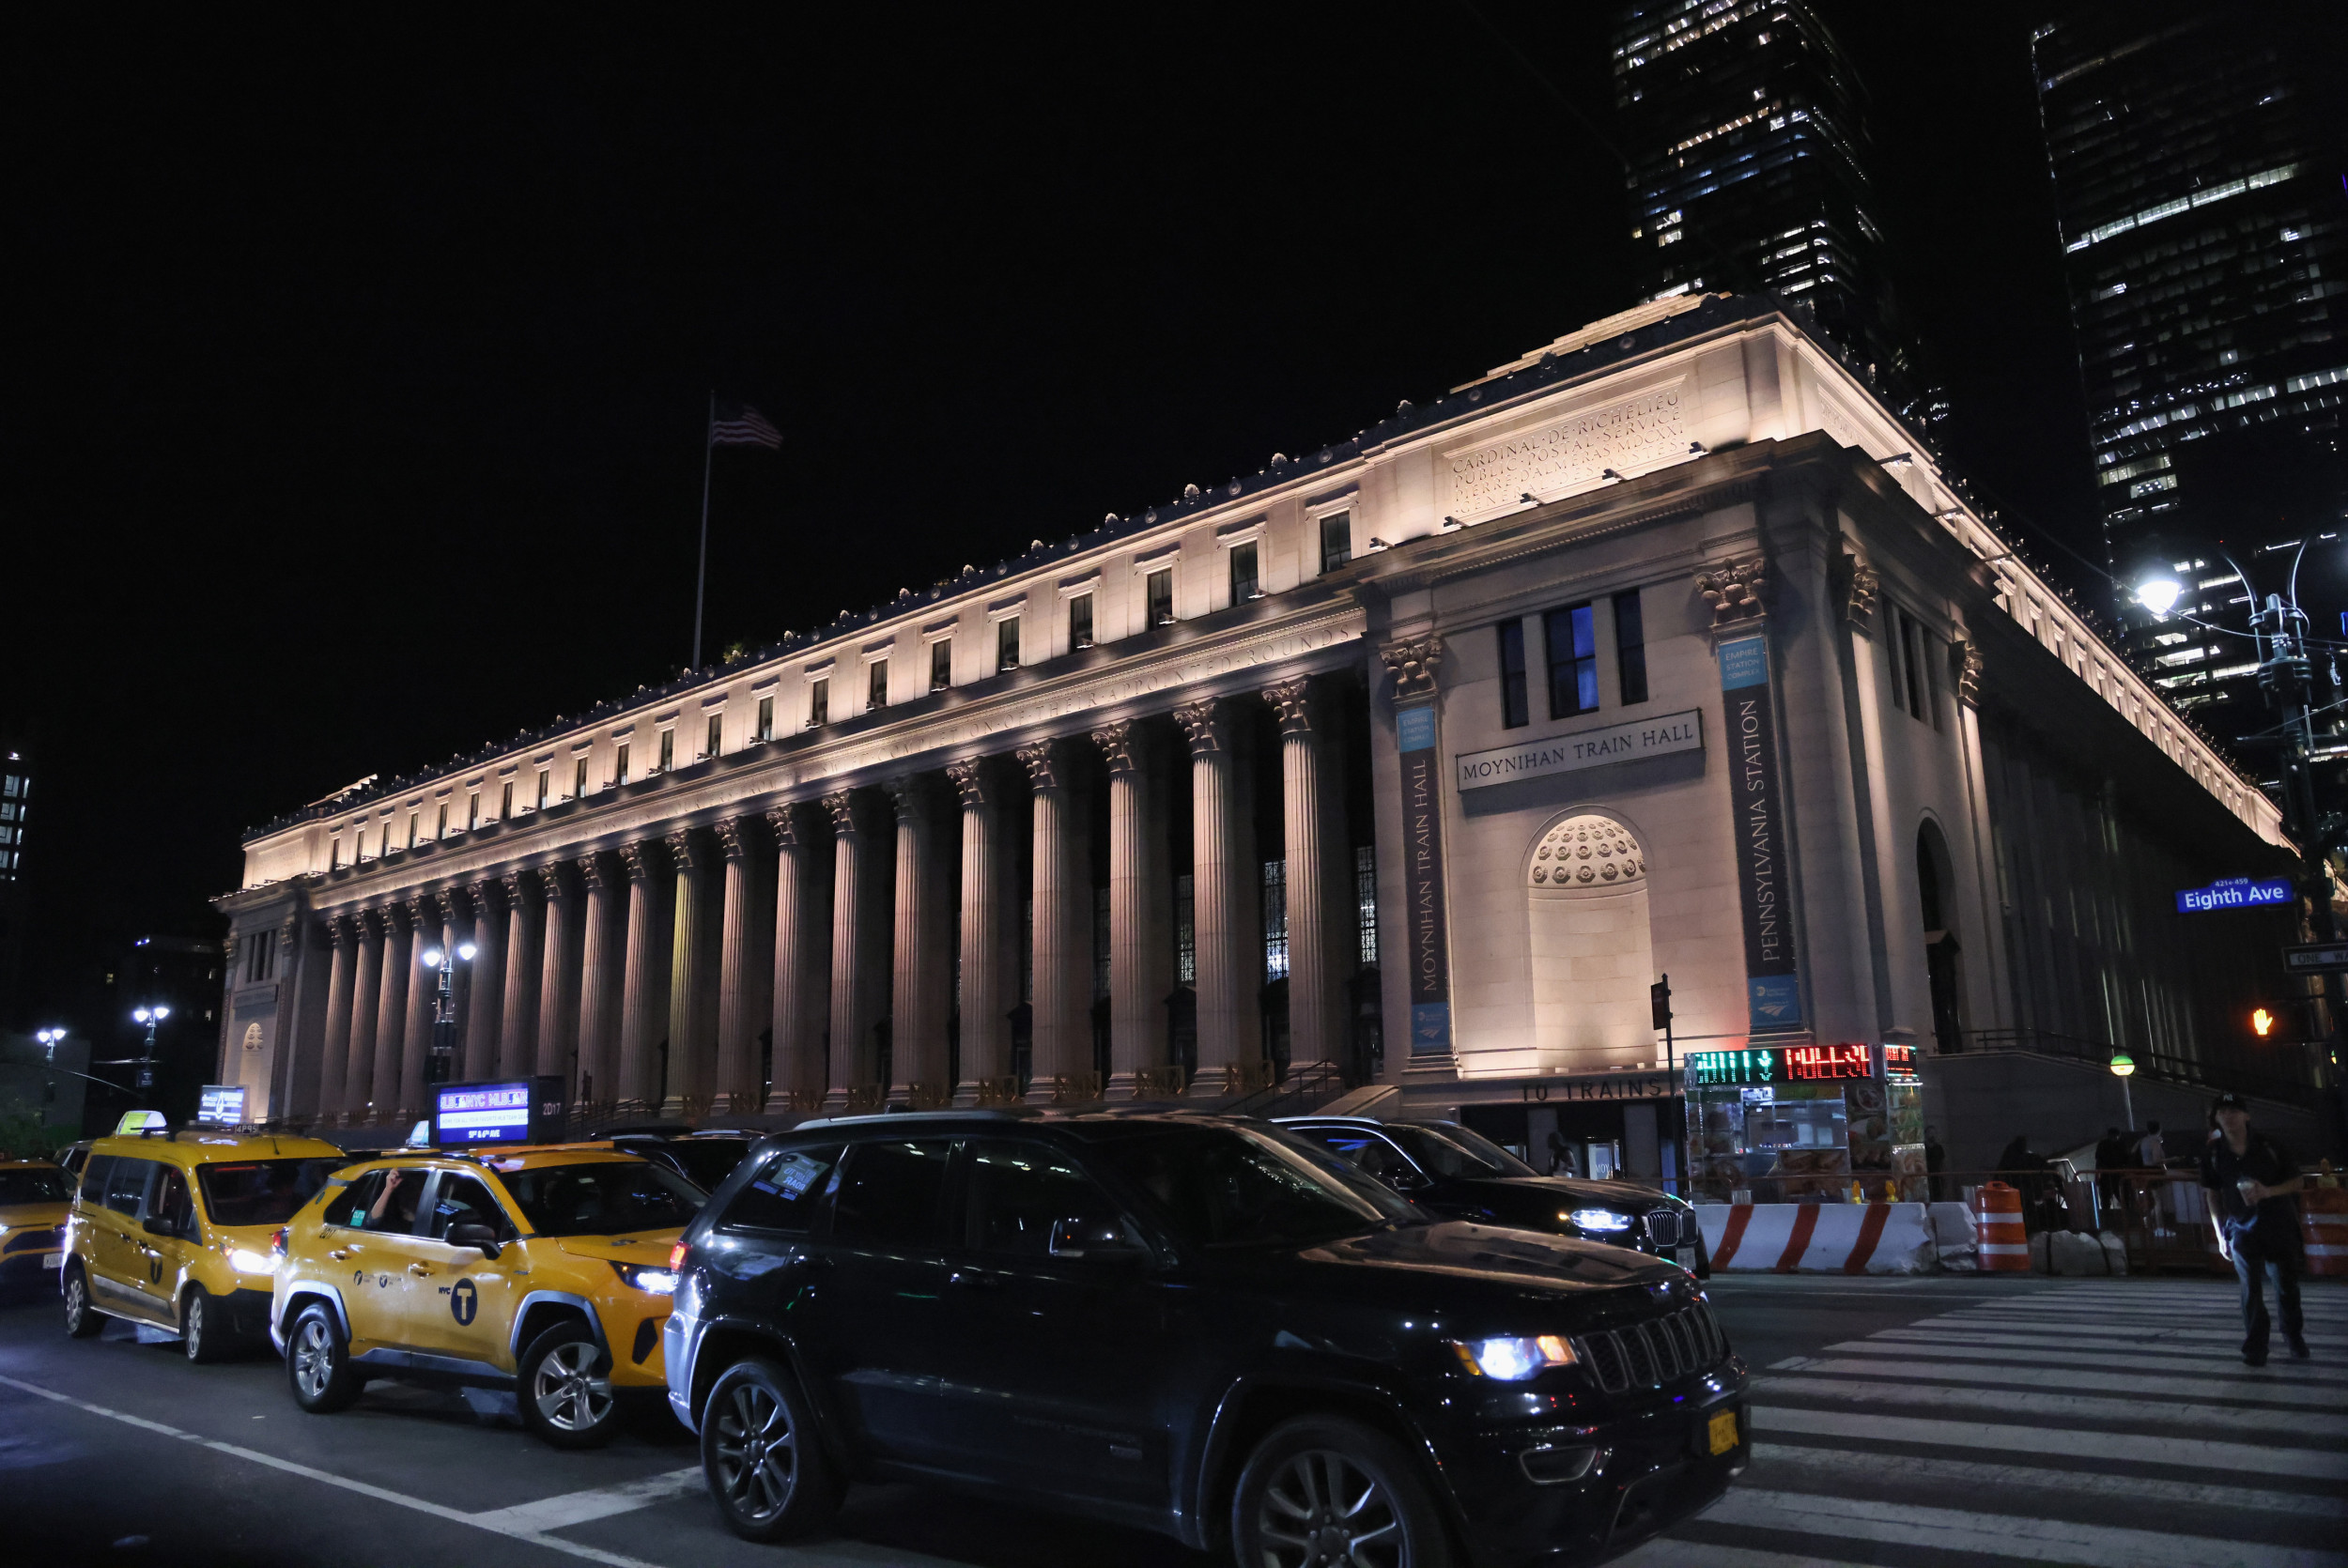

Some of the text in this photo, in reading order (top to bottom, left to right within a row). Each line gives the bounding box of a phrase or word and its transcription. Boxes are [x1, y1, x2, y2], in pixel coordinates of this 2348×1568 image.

[1453, 390, 1679, 473] CARDINAL DE RICHELIEU
[1455, 406, 1681, 488] PUBLIC POSTAL SERVICE
[1616, 421, 1685, 452] MDCXXI
[1108, 657, 1231, 700] APPOINTED
[1248, 624, 1349, 666] ROUNDS
[1725, 648, 1758, 661] EMPIRE
[1726, 659, 1760, 670] STATION
[1463, 724, 1693, 780] MOYNIHAN TRAIN HALL
[1739, 699, 1765, 792] STATION
[1413, 759, 1437, 992] MOYNIHAN TRAIN HALL
[1749, 797, 1781, 962] PENNSYLVANIA
[2185, 886, 2284, 910] Eighth Ave
[2297, 953, 2323, 964] ONE
[1522, 1079, 1661, 1102] TO TRAINS
[543, 1102, 561, 1115] 2D17
[439, 1286, 451, 1295] NYC
